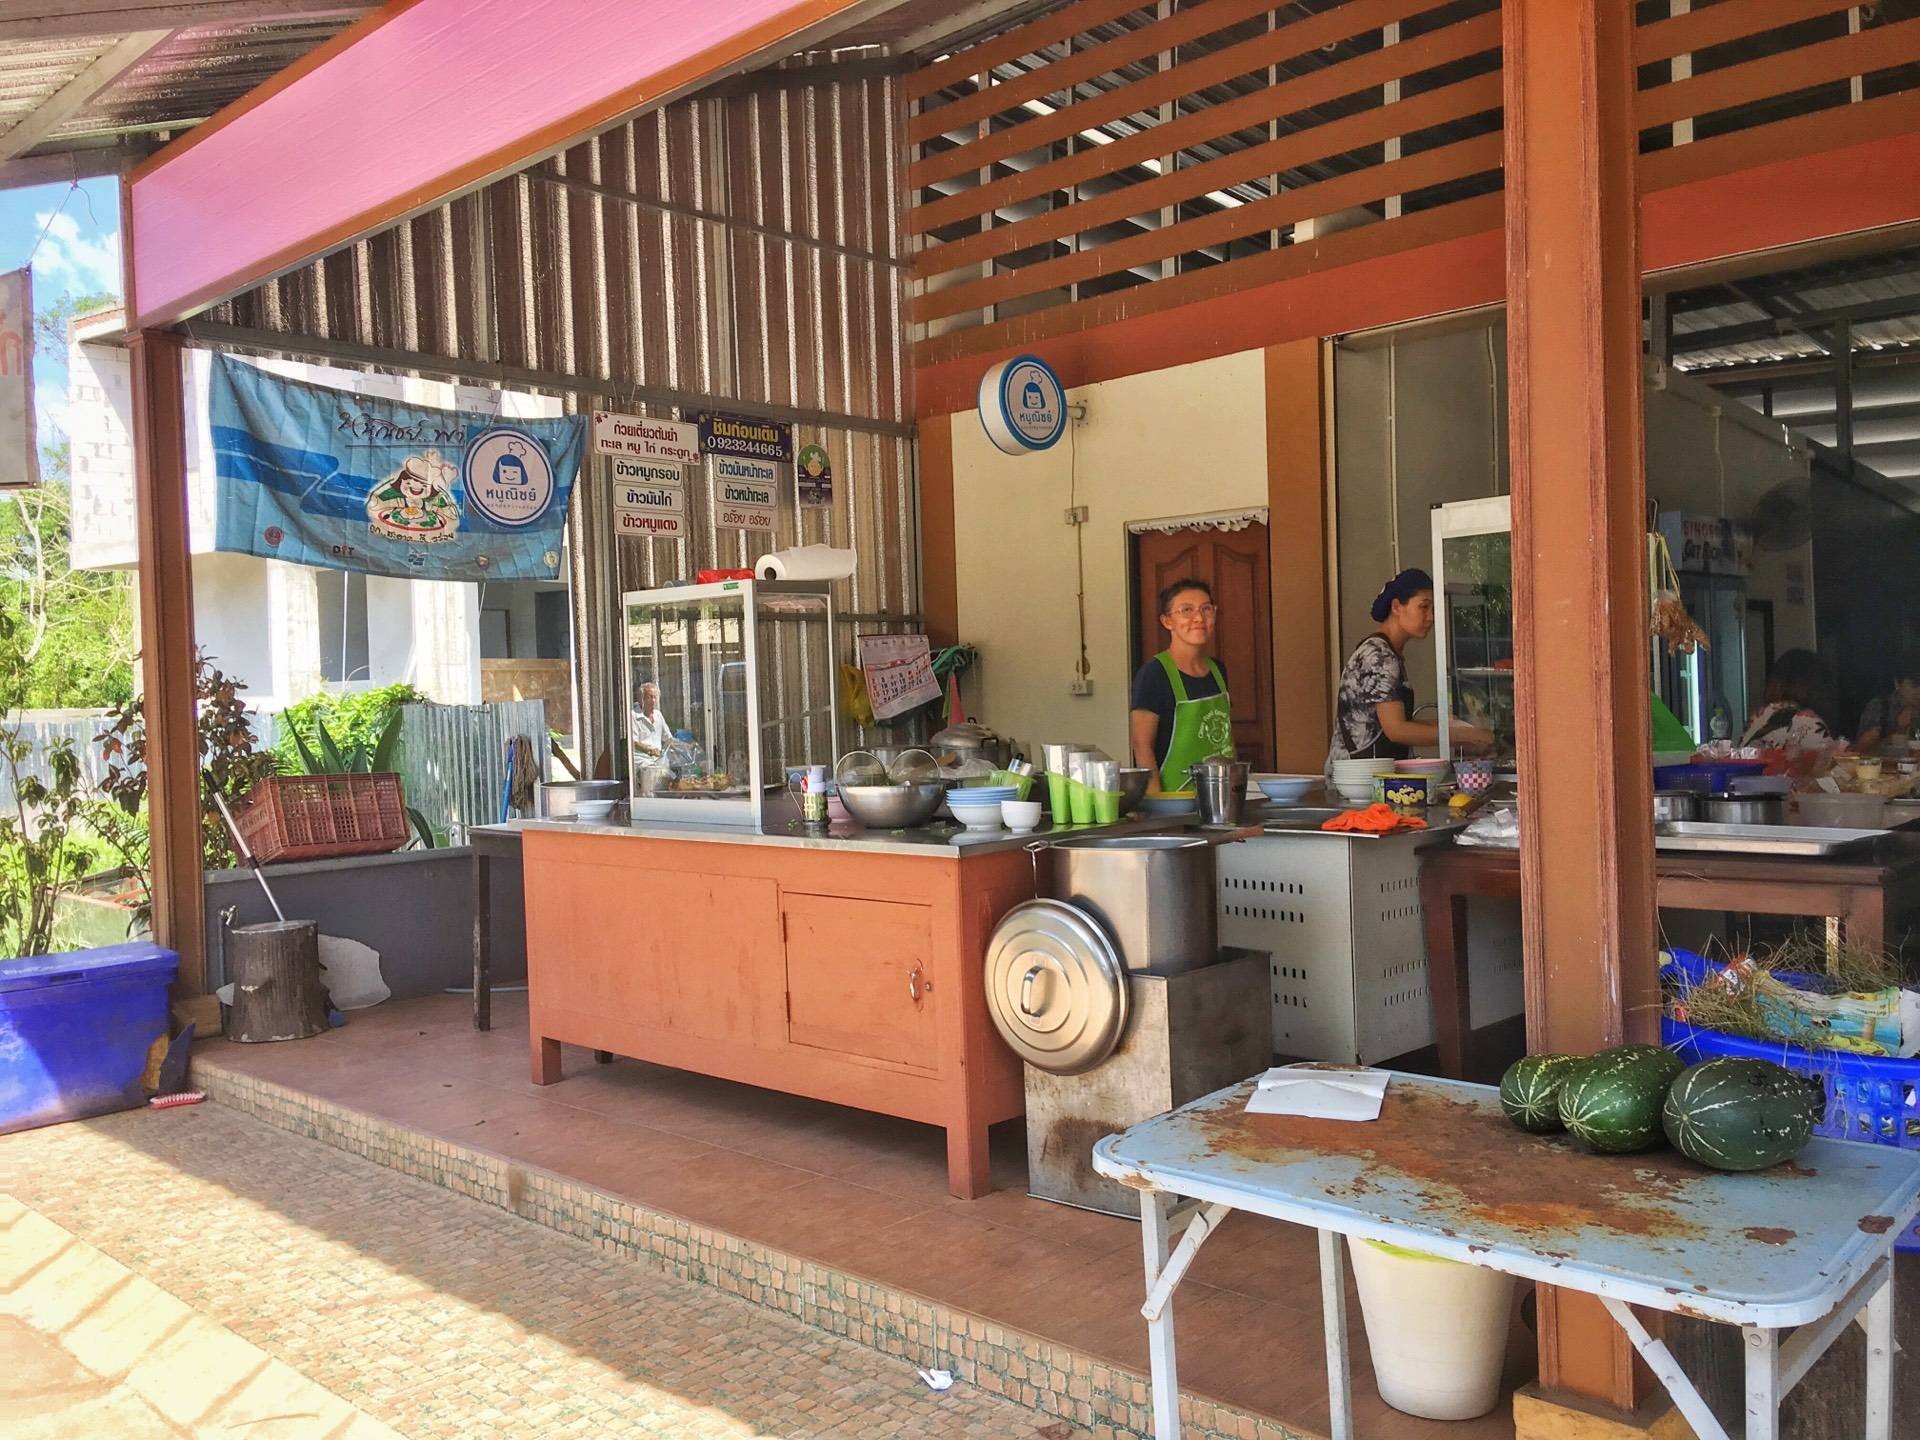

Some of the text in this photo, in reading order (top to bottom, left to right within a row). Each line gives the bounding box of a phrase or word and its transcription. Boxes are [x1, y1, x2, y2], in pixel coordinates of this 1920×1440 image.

[713, 417, 778, 443] ชิมก่อนเติม
[601, 439, 690, 459] ทะเล หมู ไก่ กระดูก
[707, 435, 783, 457] 0923244665
[617, 461, 680, 481] ข้าวหมูกรอบ
[719, 459, 774, 480] ข้าวมันหน้าทะเล
[486, 487, 537, 503] หนูณิชย์
[627, 489, 672, 506] ข้าวมันไก่
[725, 484, 769, 503] ข้าวหน้าทะเล
[623, 513, 678, 533] ข้าวหมูแดง
